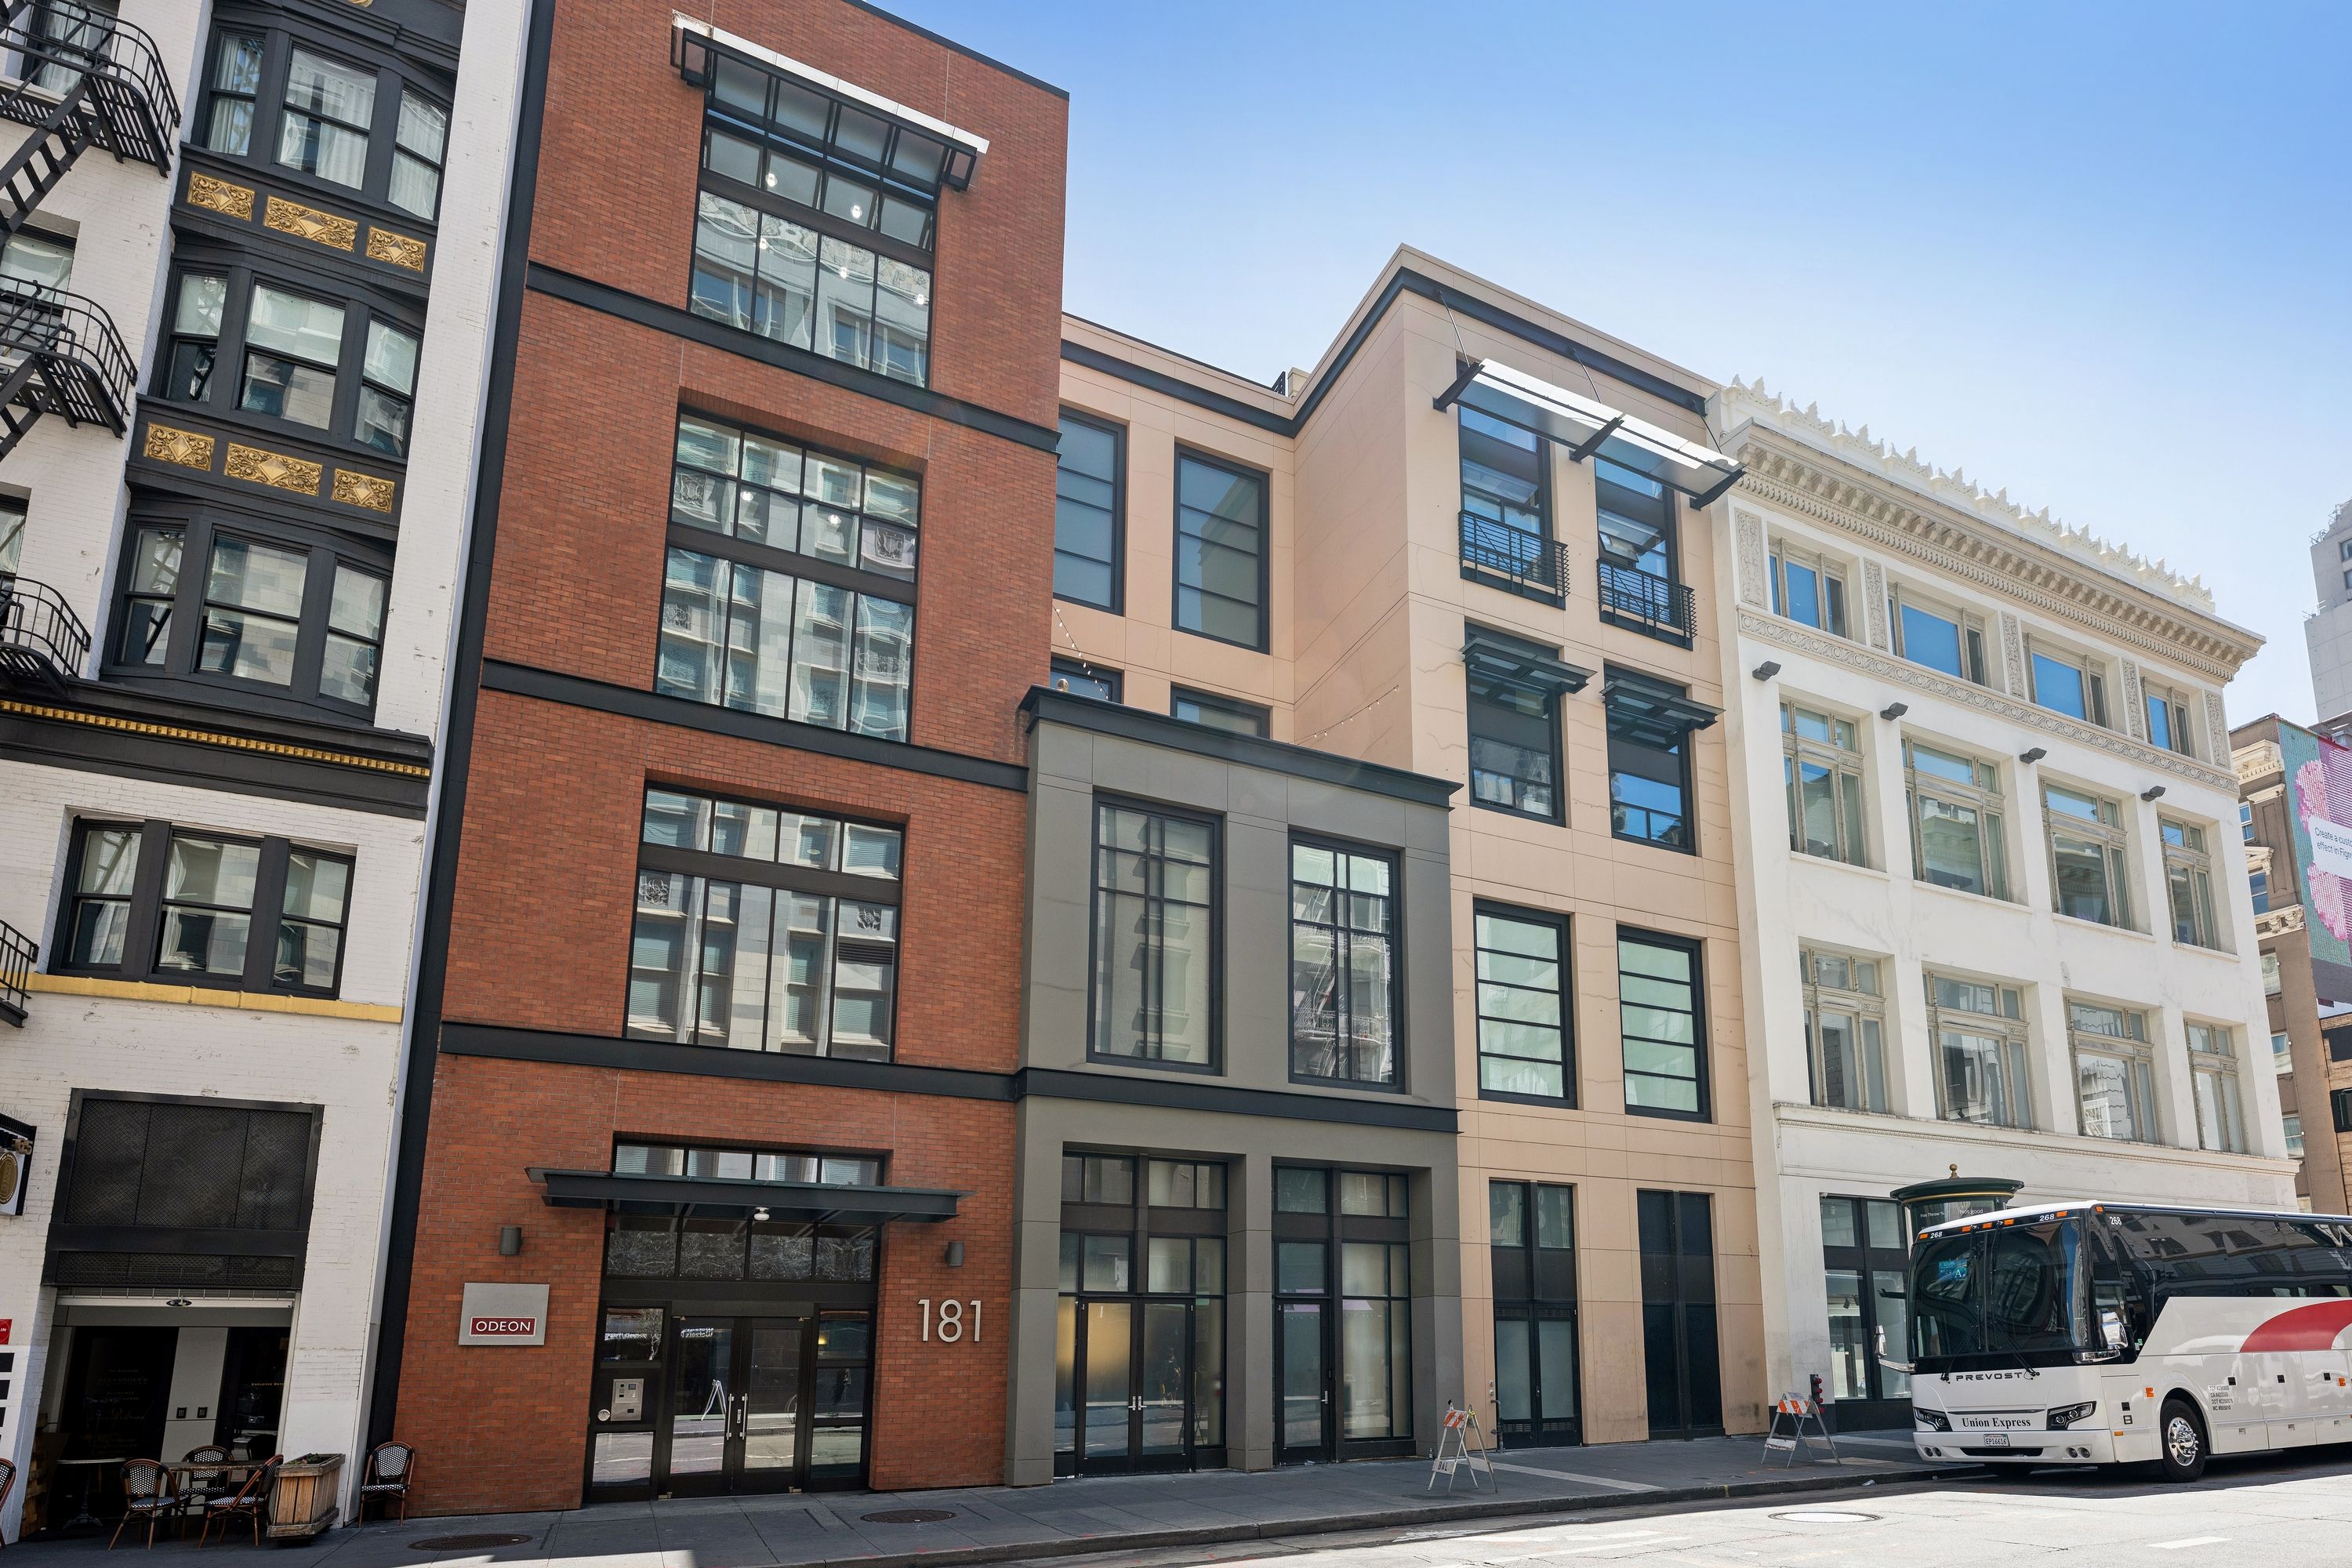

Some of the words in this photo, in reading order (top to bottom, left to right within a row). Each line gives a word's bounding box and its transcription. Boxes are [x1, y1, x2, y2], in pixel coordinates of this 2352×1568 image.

[2315, 827, 2333, 841] Create
[2317, 841, 2333, 853] effect
[2333, 846, 2339, 855] in
[2109, 1216, 2122, 1225] 268
[476, 1321, 531, 1331] ODEON
[917, 1299, 981, 1342] 181
[1955, 1372, 2023, 1381] PREVOST
[1962, 1417, 1990, 1427] Union
[1992, 1417, 2031, 1429] Express
